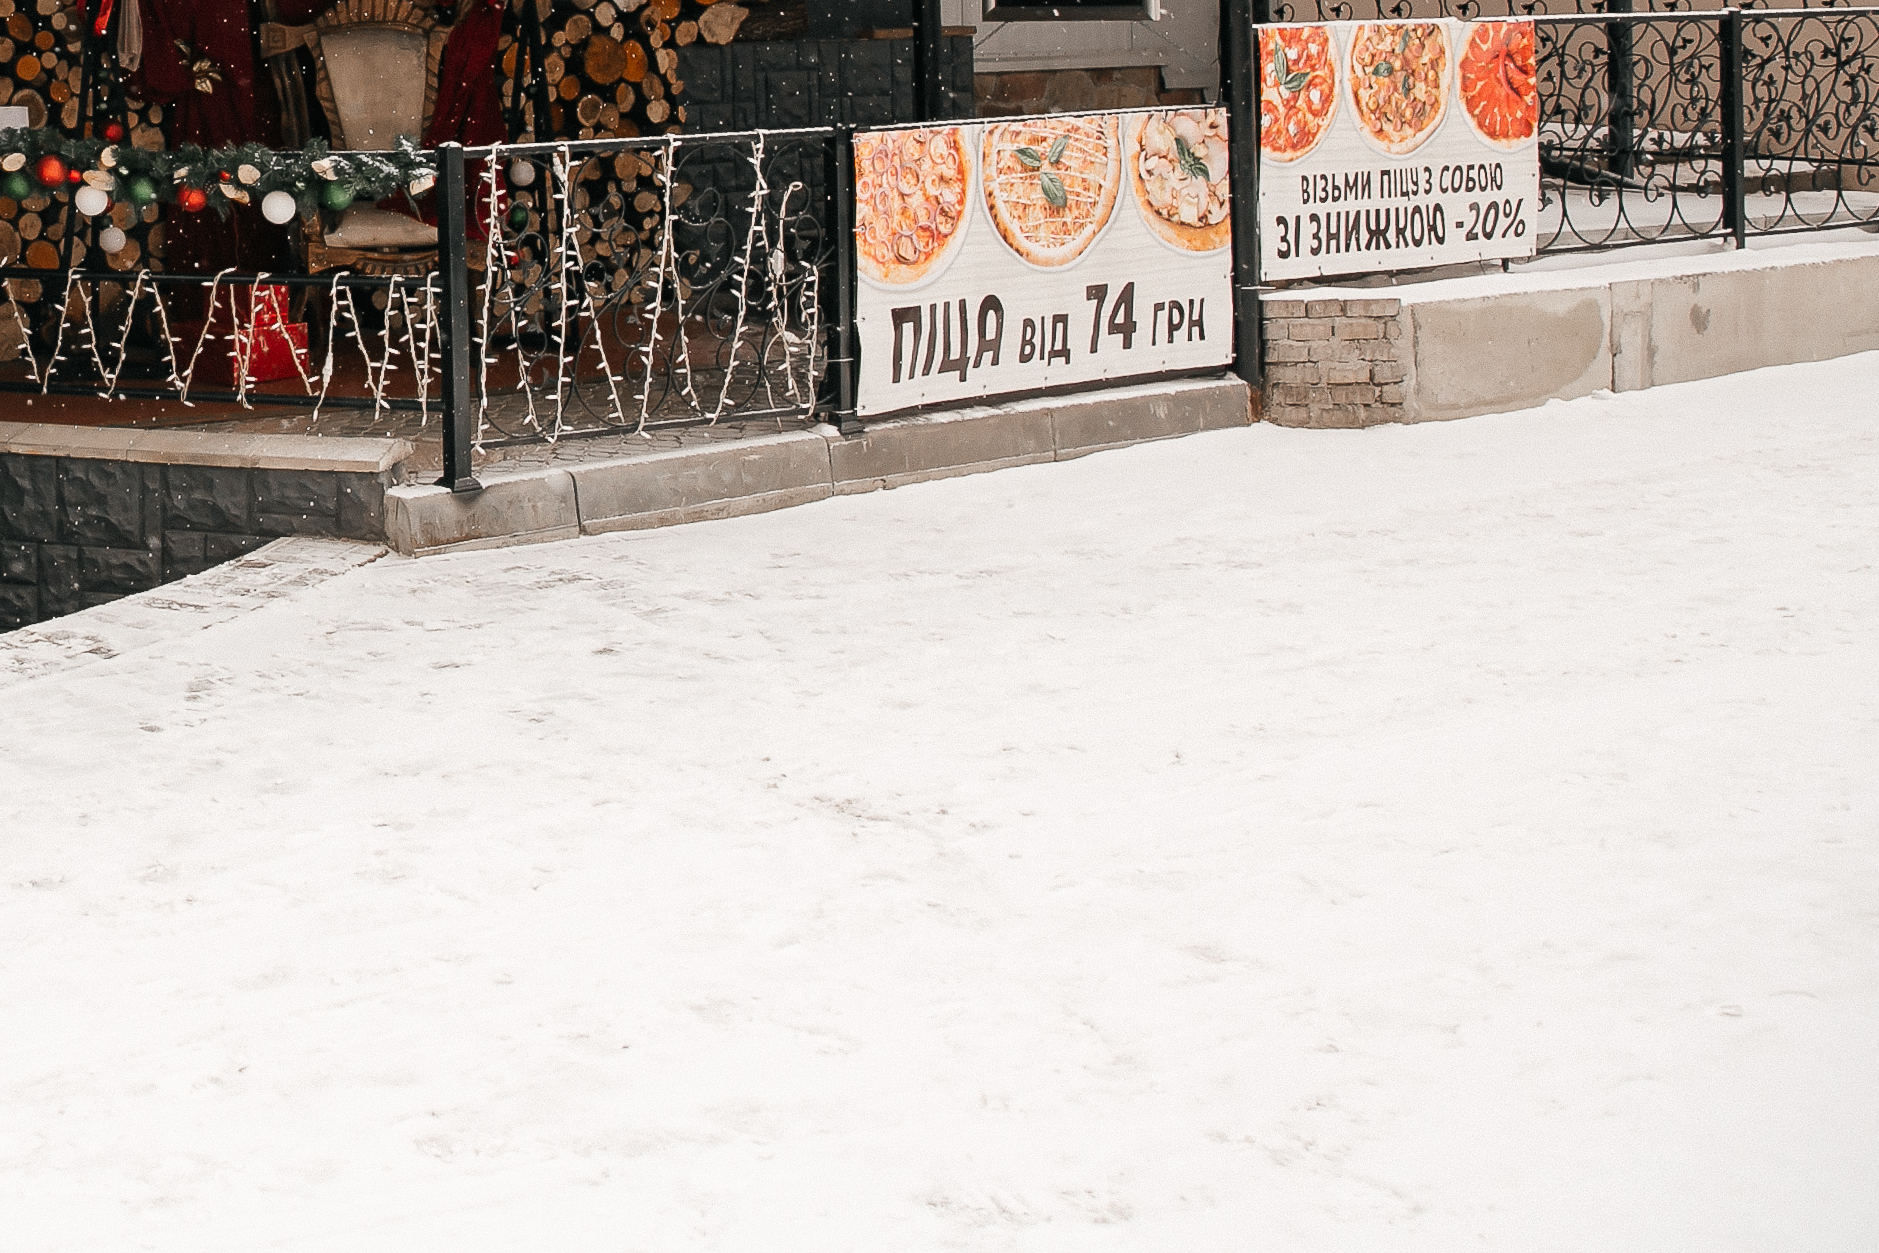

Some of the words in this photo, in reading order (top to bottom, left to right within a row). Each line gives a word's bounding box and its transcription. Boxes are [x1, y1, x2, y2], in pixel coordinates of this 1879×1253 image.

[1300, 170, 1371, 204] ВІЗЬМИ
[1379, 167, 1420, 201] ПІЦУ
[1423, 166, 1434, 195] З
[1439, 162, 1504, 194] СОБОЮ
[1275, 214, 1302, 259] ЗІ
[1308, 202, 1446, 256] ЗНИЖКОЮ
[1455, 198, 1526, 242] -20%
[891, 295, 1004, 383] ПІЦА
[1085, 281, 1137, 354] 74
[1151, 297, 1206, 346] ГРН
